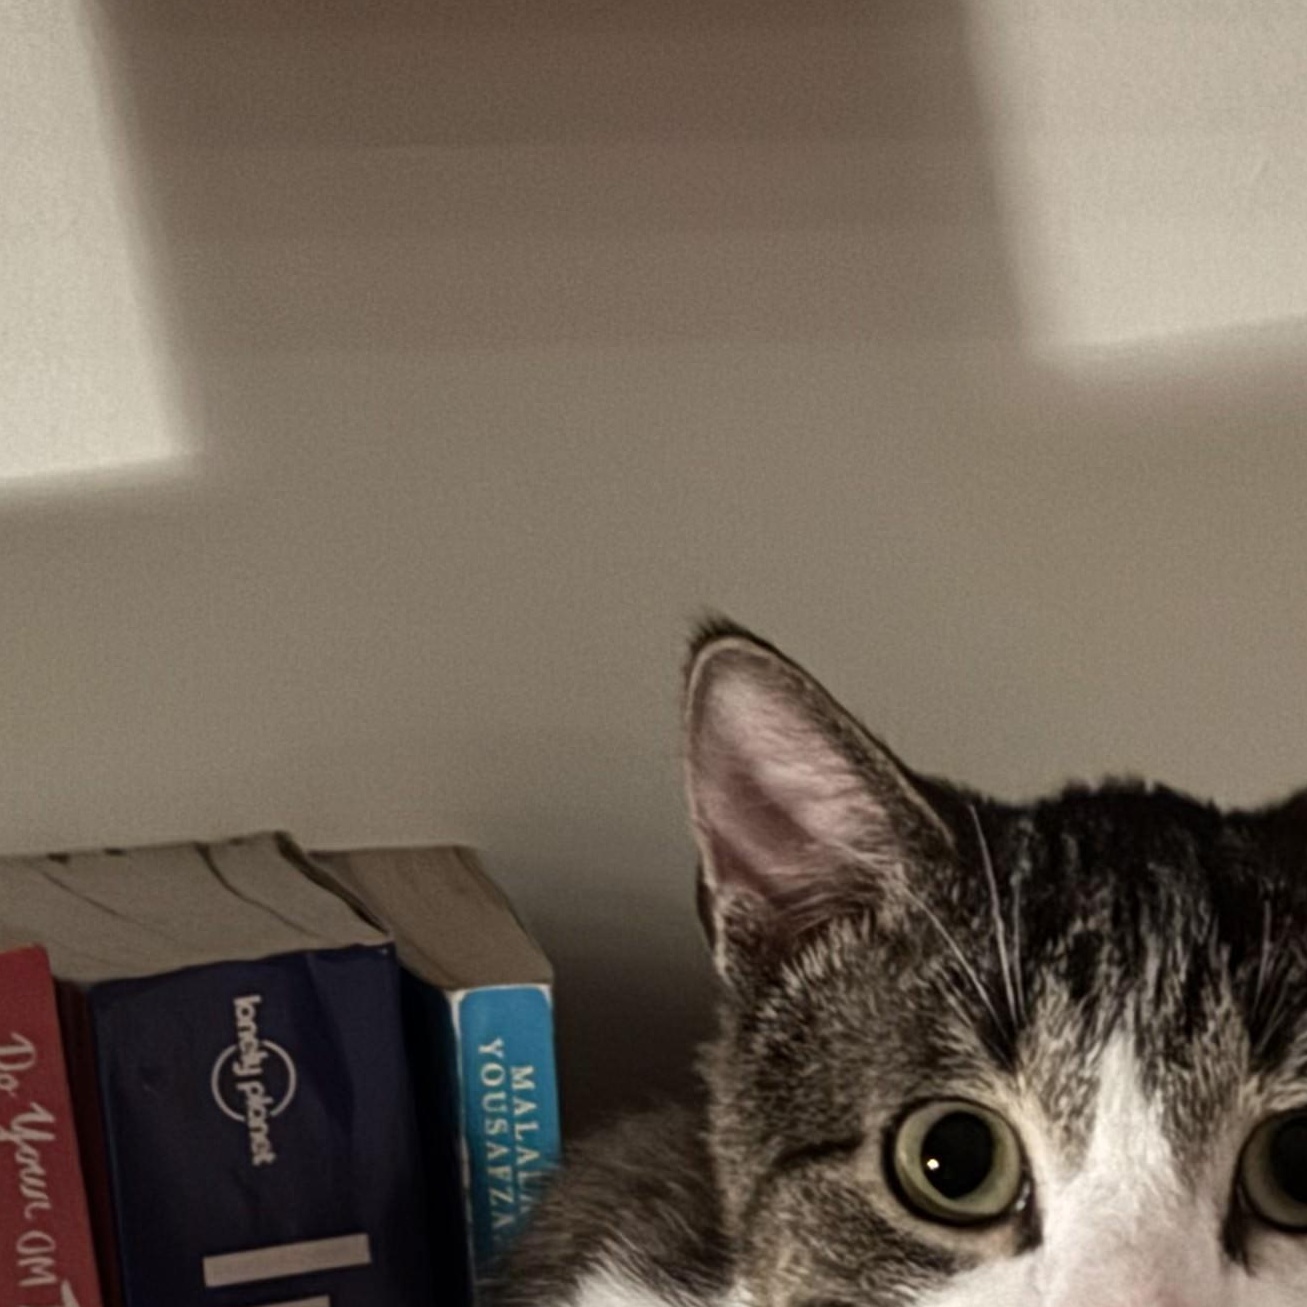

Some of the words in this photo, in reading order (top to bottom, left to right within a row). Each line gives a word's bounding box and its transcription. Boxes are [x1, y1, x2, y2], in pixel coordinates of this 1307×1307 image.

[231, 993, 270, 1076] lonely
[0, 1101, 56, 1220] Your
[234, 1080, 278, 1168] planet
[478, 1037, 516, 1243] YOUSAFZA
